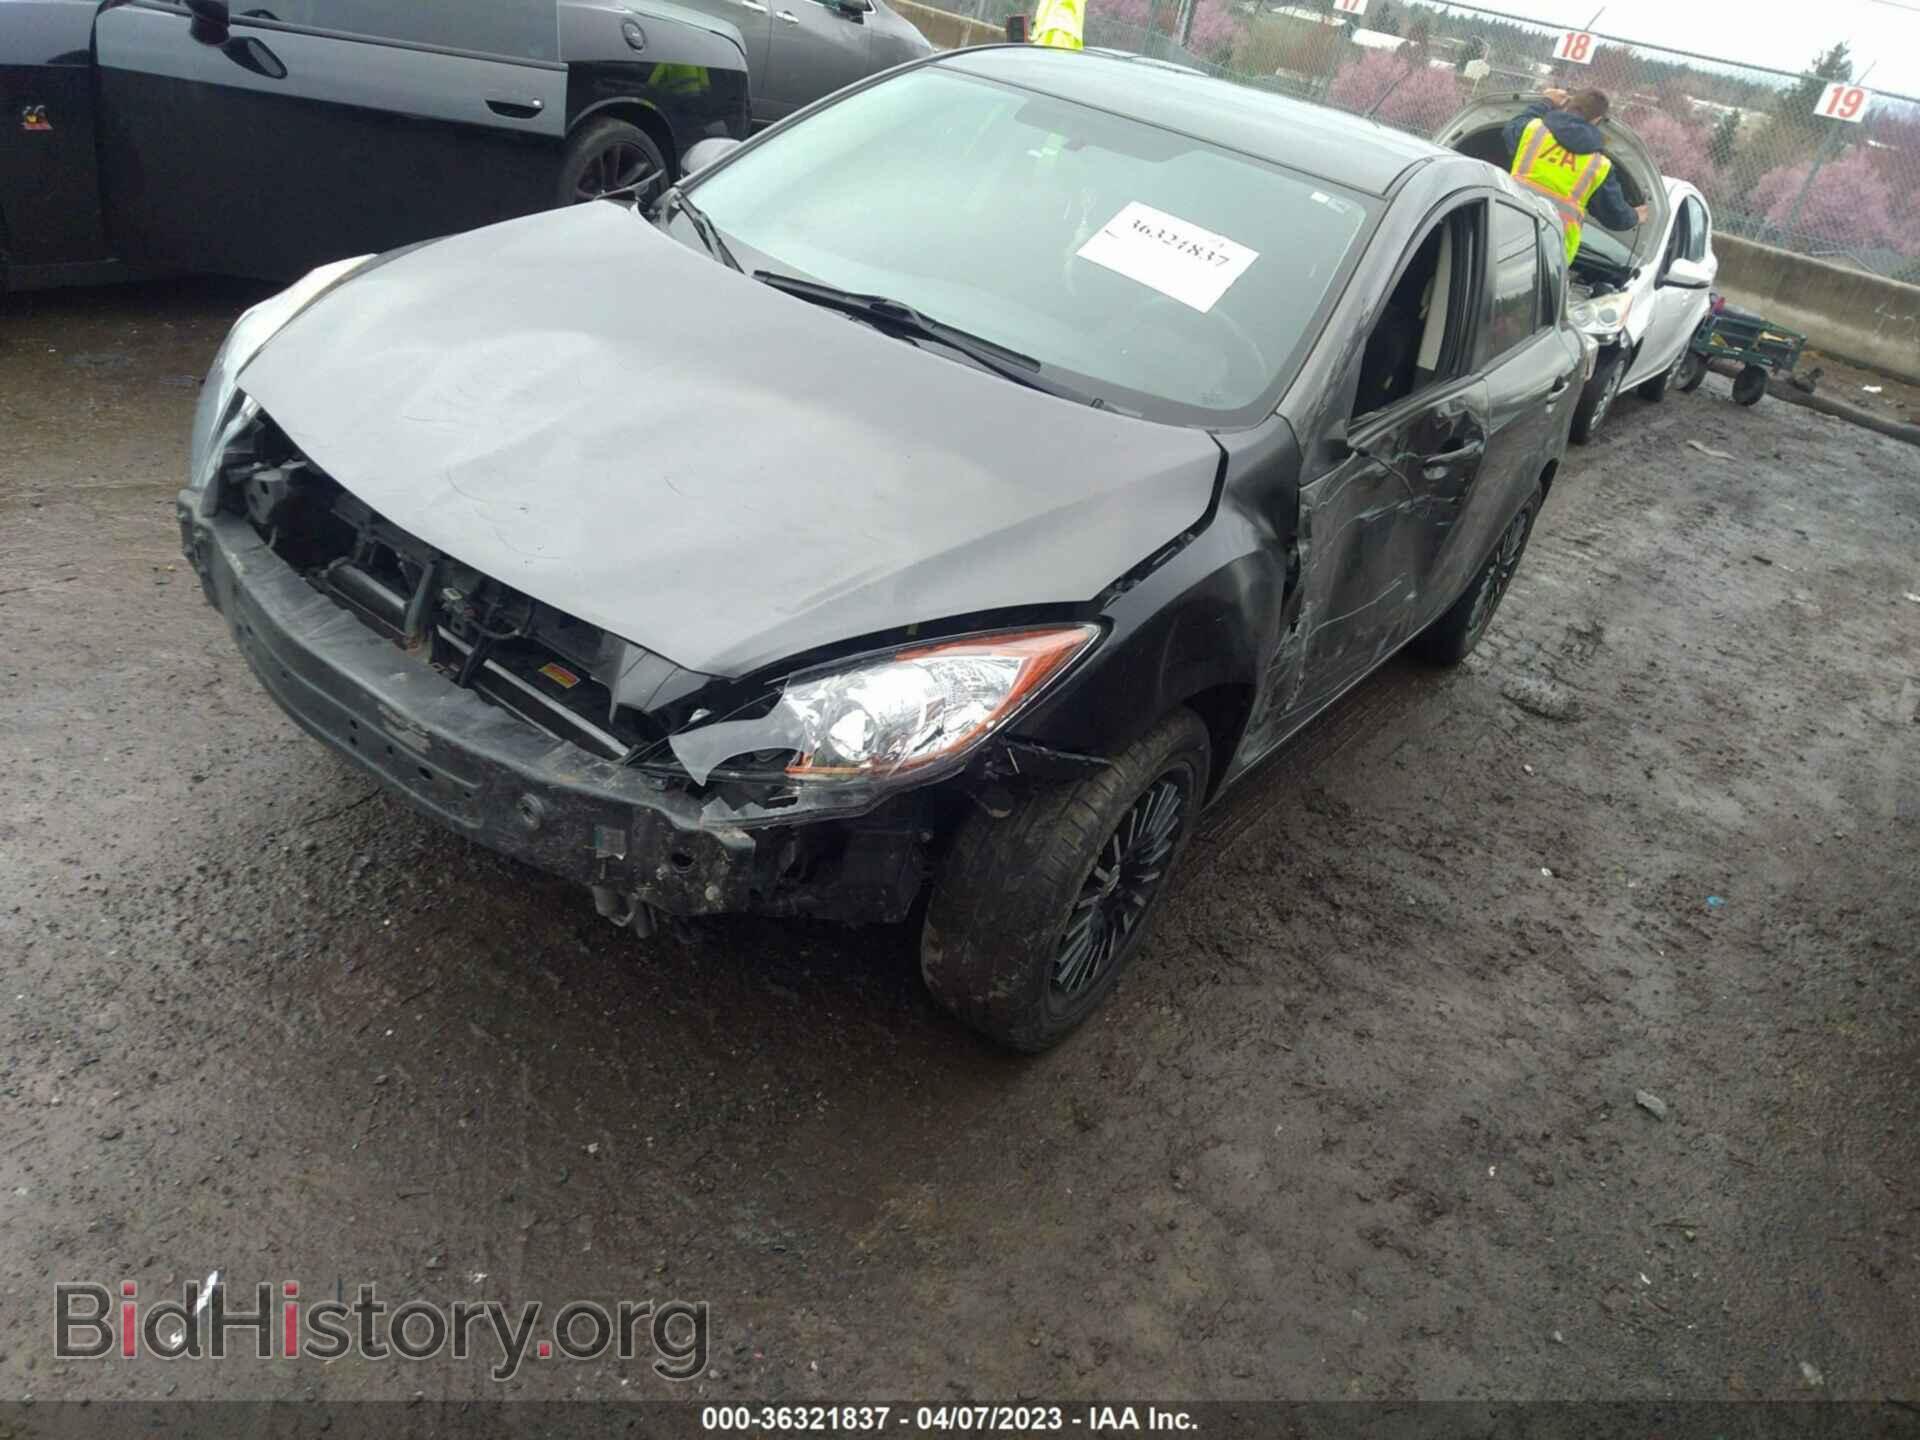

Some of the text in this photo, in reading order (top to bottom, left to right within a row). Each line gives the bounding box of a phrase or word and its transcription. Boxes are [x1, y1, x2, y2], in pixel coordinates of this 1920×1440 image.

[1561, 32, 1591, 61] 18
[1825, 86, 1865, 118] 19
[1131, 217, 1231, 268] 36321837
